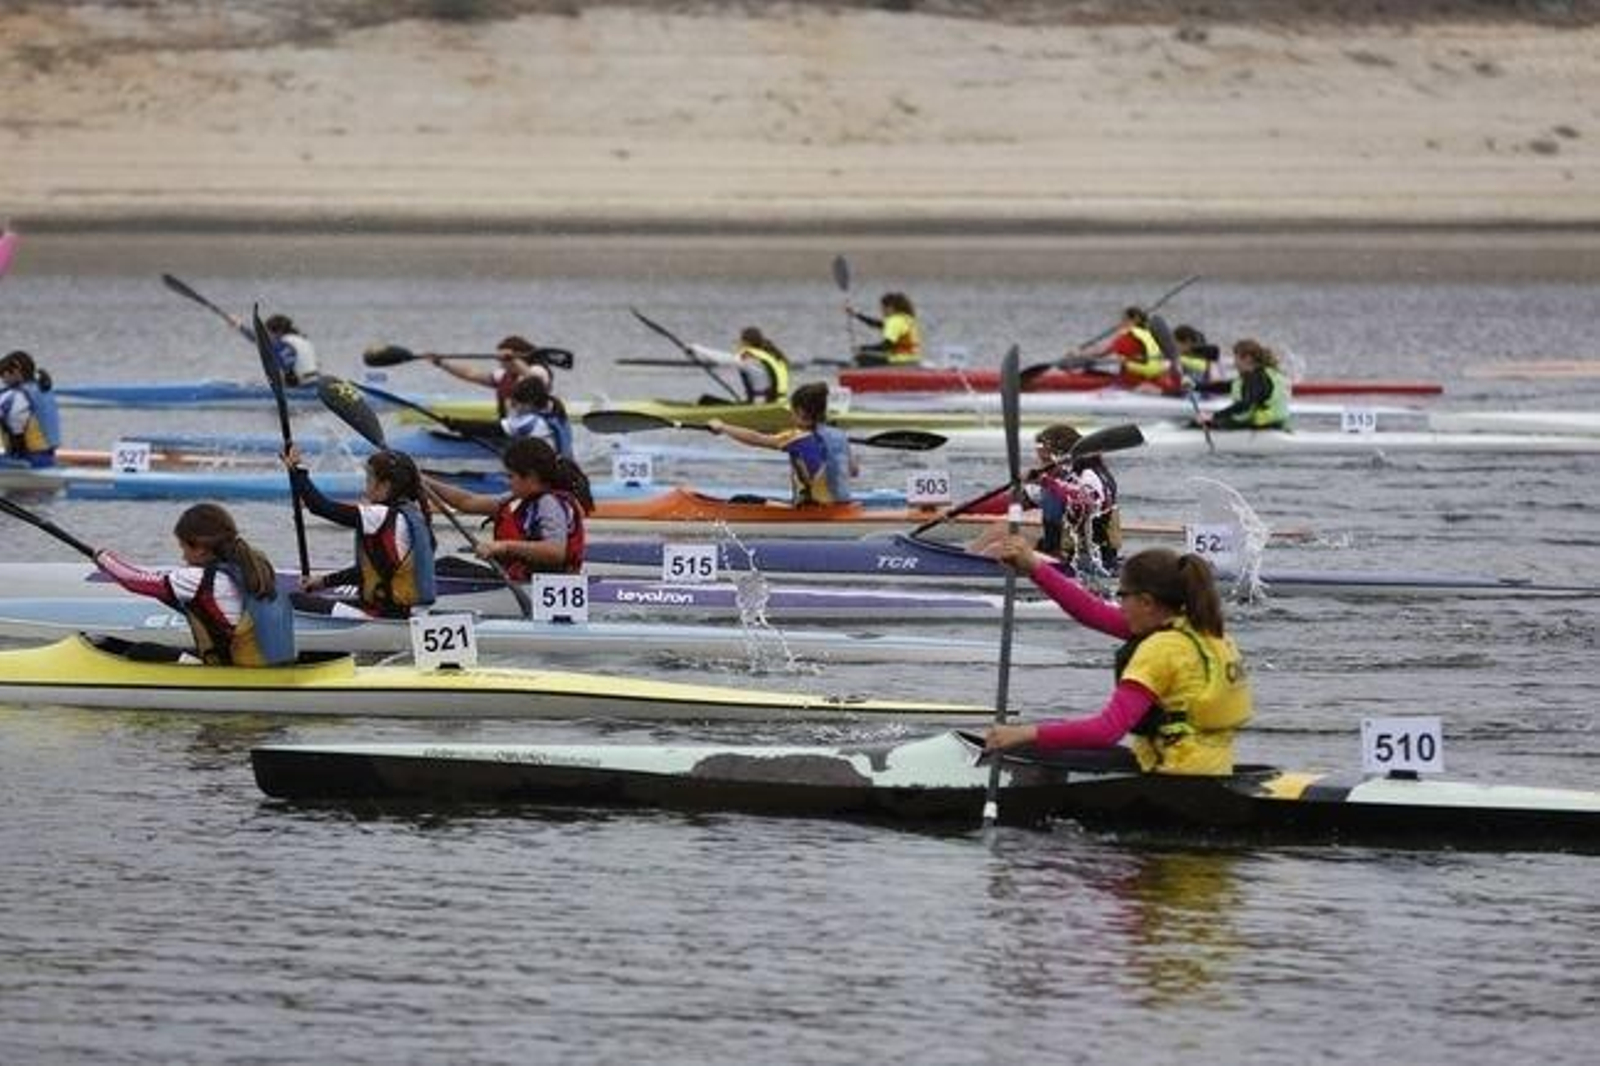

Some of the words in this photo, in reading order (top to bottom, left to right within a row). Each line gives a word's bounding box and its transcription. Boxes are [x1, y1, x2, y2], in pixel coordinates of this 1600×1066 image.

[117, 451, 145, 464] 527
[619, 463, 648, 479] 528
[915, 478, 947, 494] 503
[1195, 533, 1231, 553] 52
[671, 556, 711, 575] 515
[877, 557, 918, 569] TCR
[542, 587, 584, 607] 518
[424, 626, 469, 652] 521
[1375, 733, 1436, 762] 510
